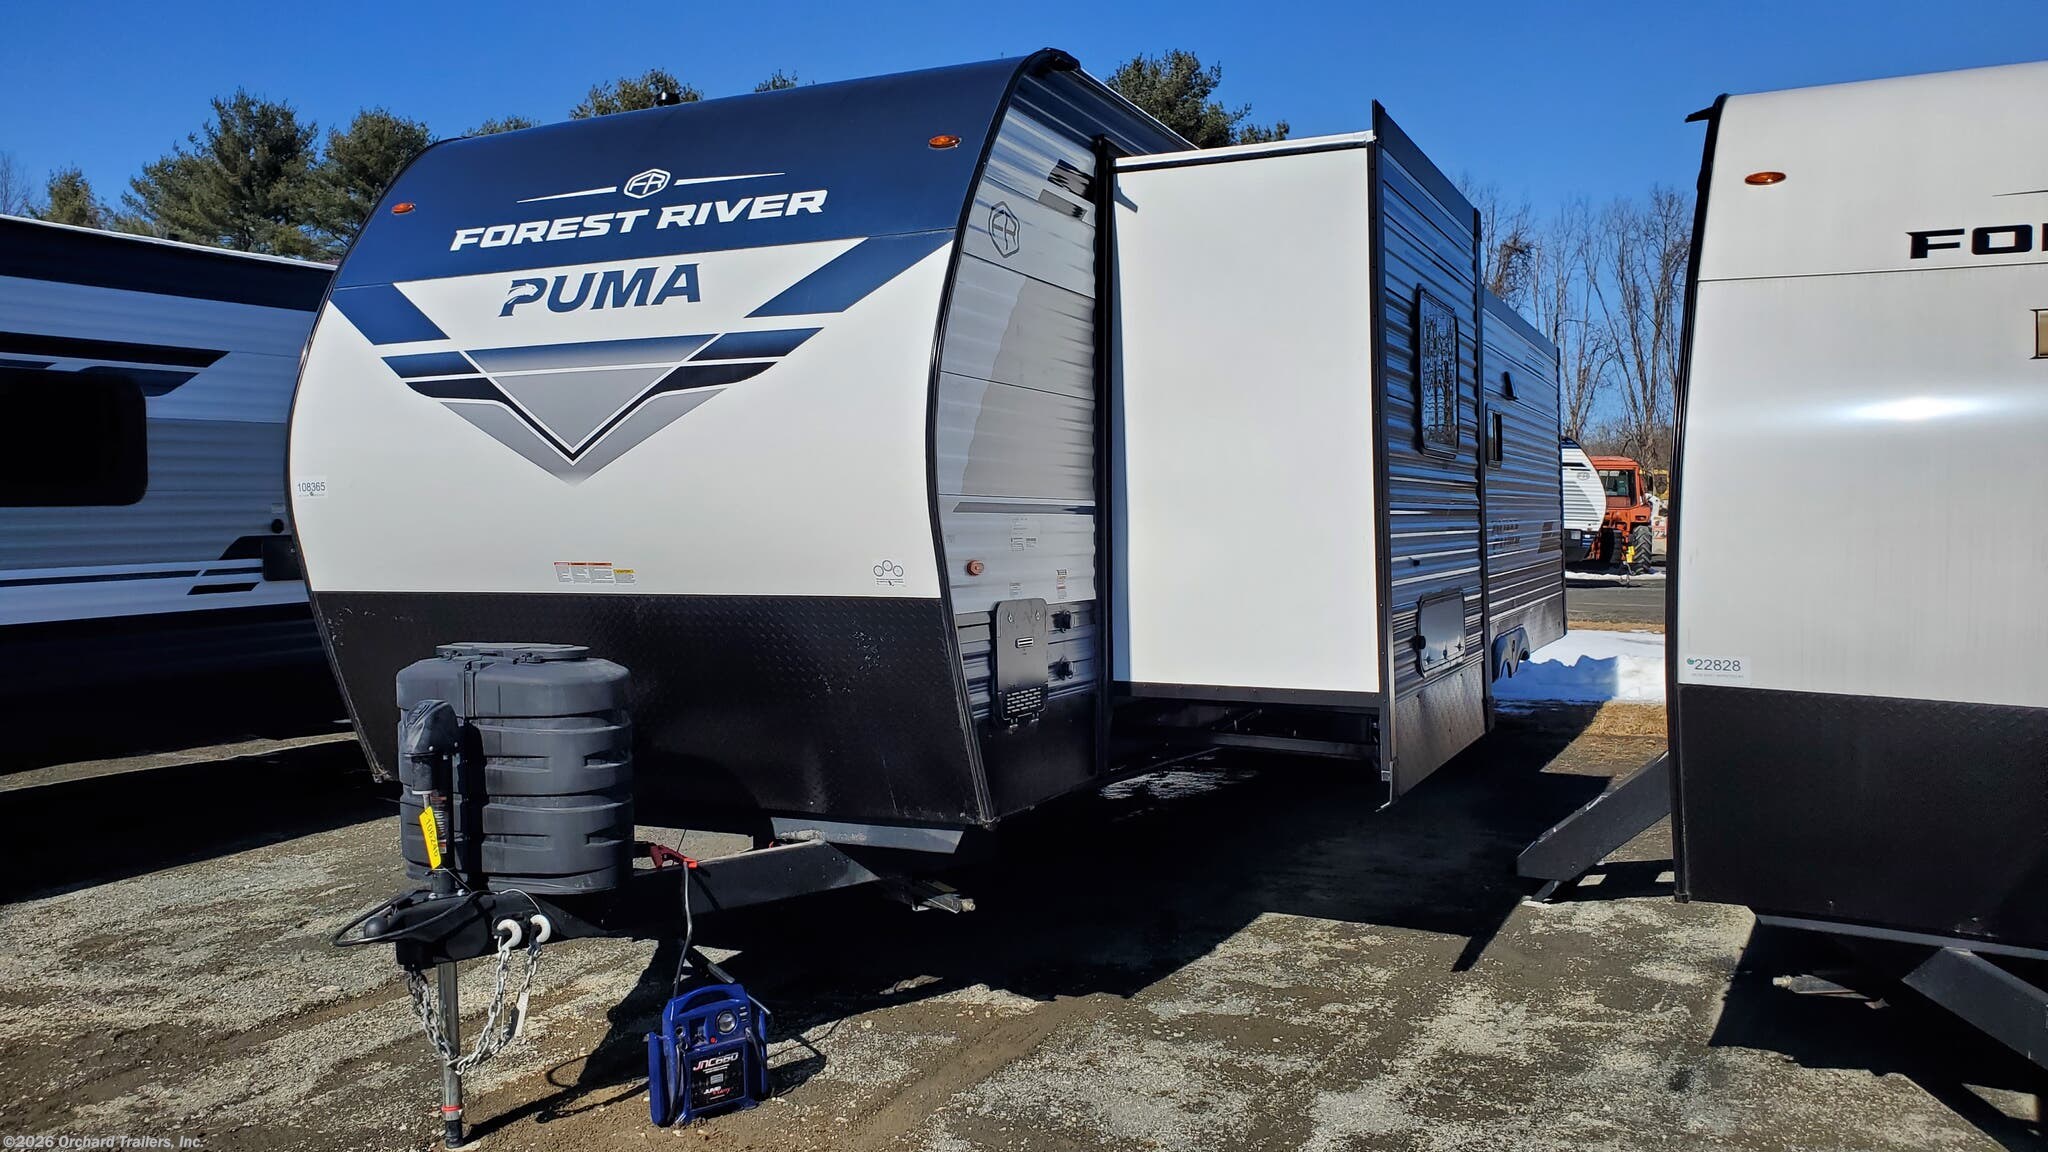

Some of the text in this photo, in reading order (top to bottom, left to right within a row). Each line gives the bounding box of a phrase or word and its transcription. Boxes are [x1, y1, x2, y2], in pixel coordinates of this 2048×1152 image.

[450, 189, 828, 251] FOREST RIVER
[1905, 223, 2048, 259] FO
[498, 263, 701, 317] PUMA
[298, 482, 326, 492] 108365
[1694, 658, 1741, 672] 22828
